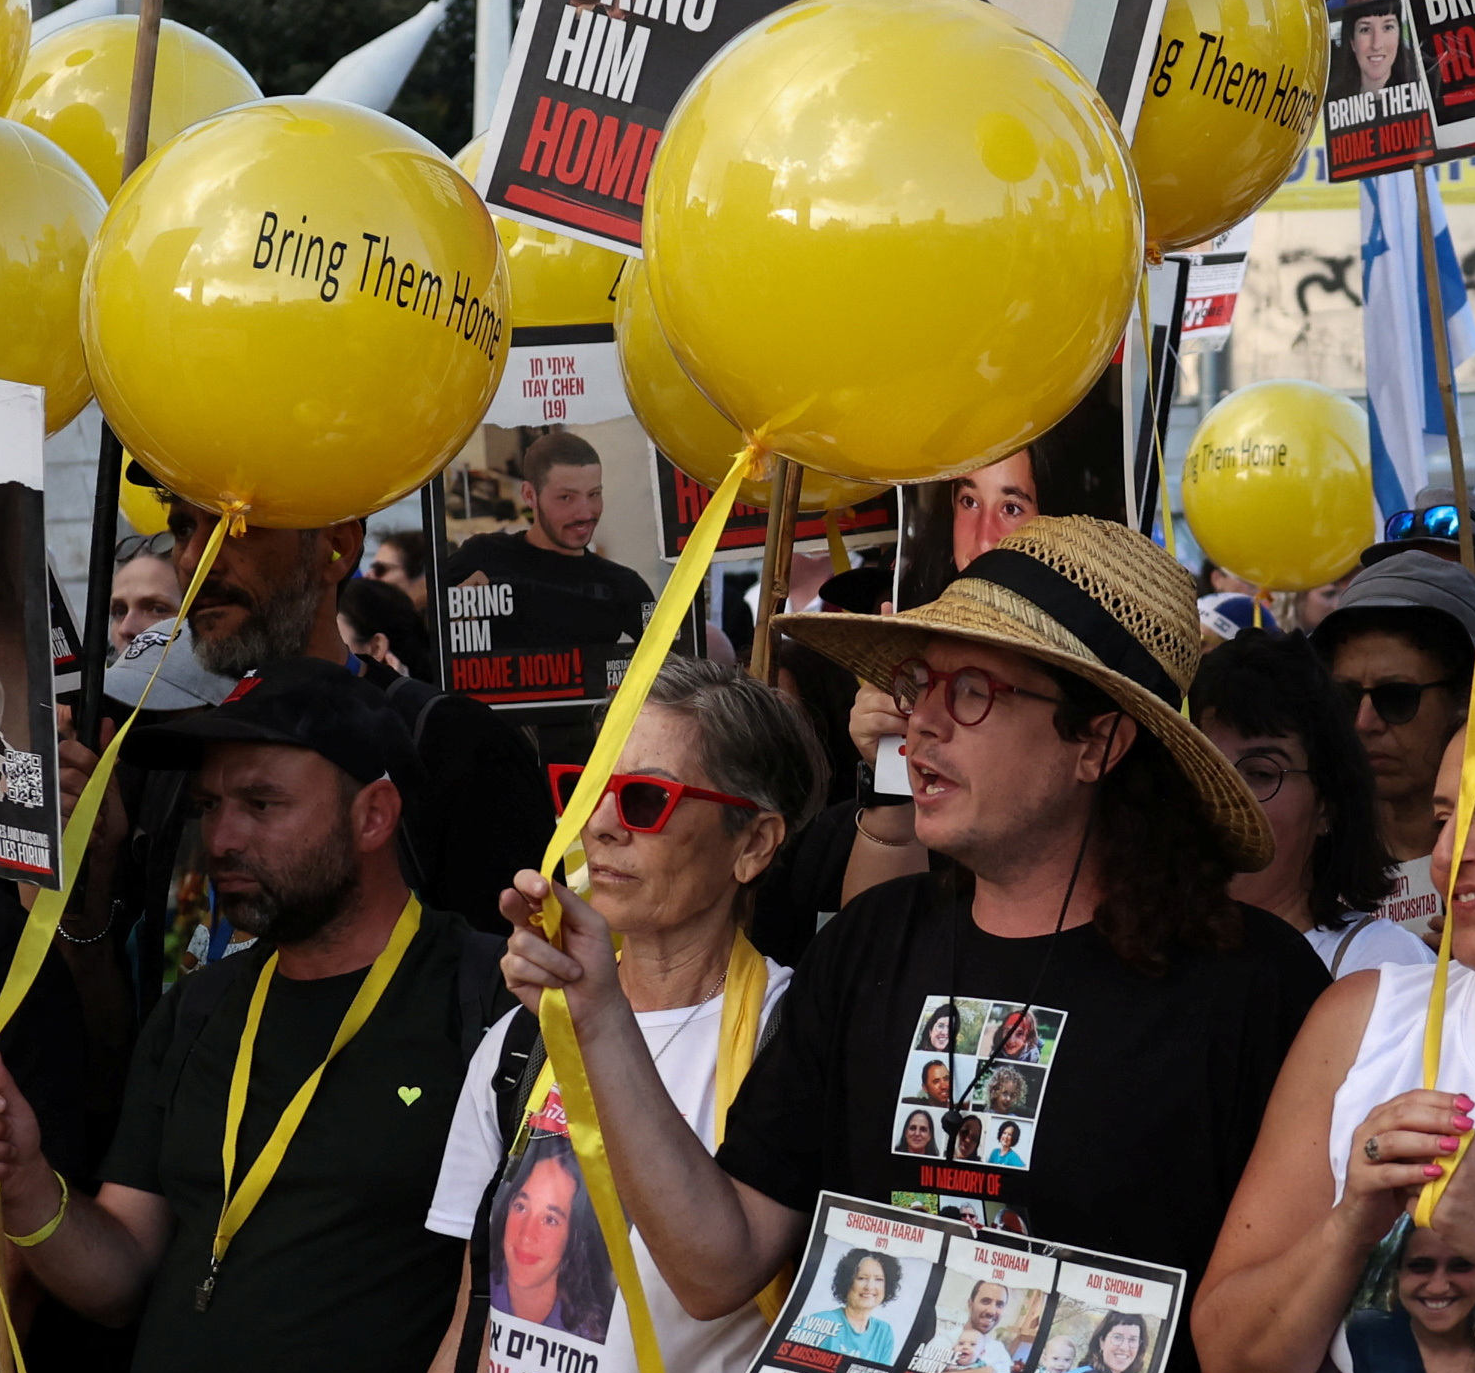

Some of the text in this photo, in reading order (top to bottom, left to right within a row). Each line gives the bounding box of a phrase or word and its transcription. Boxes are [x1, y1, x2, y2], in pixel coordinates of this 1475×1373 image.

[253, 211, 503, 361] Bring Them Home
[1241, 437, 1288, 469] Home
[921, 1165, 1002, 1197] IN MEMORY OF
[847, 1212, 925, 1244] SHOSHAN HARAN
